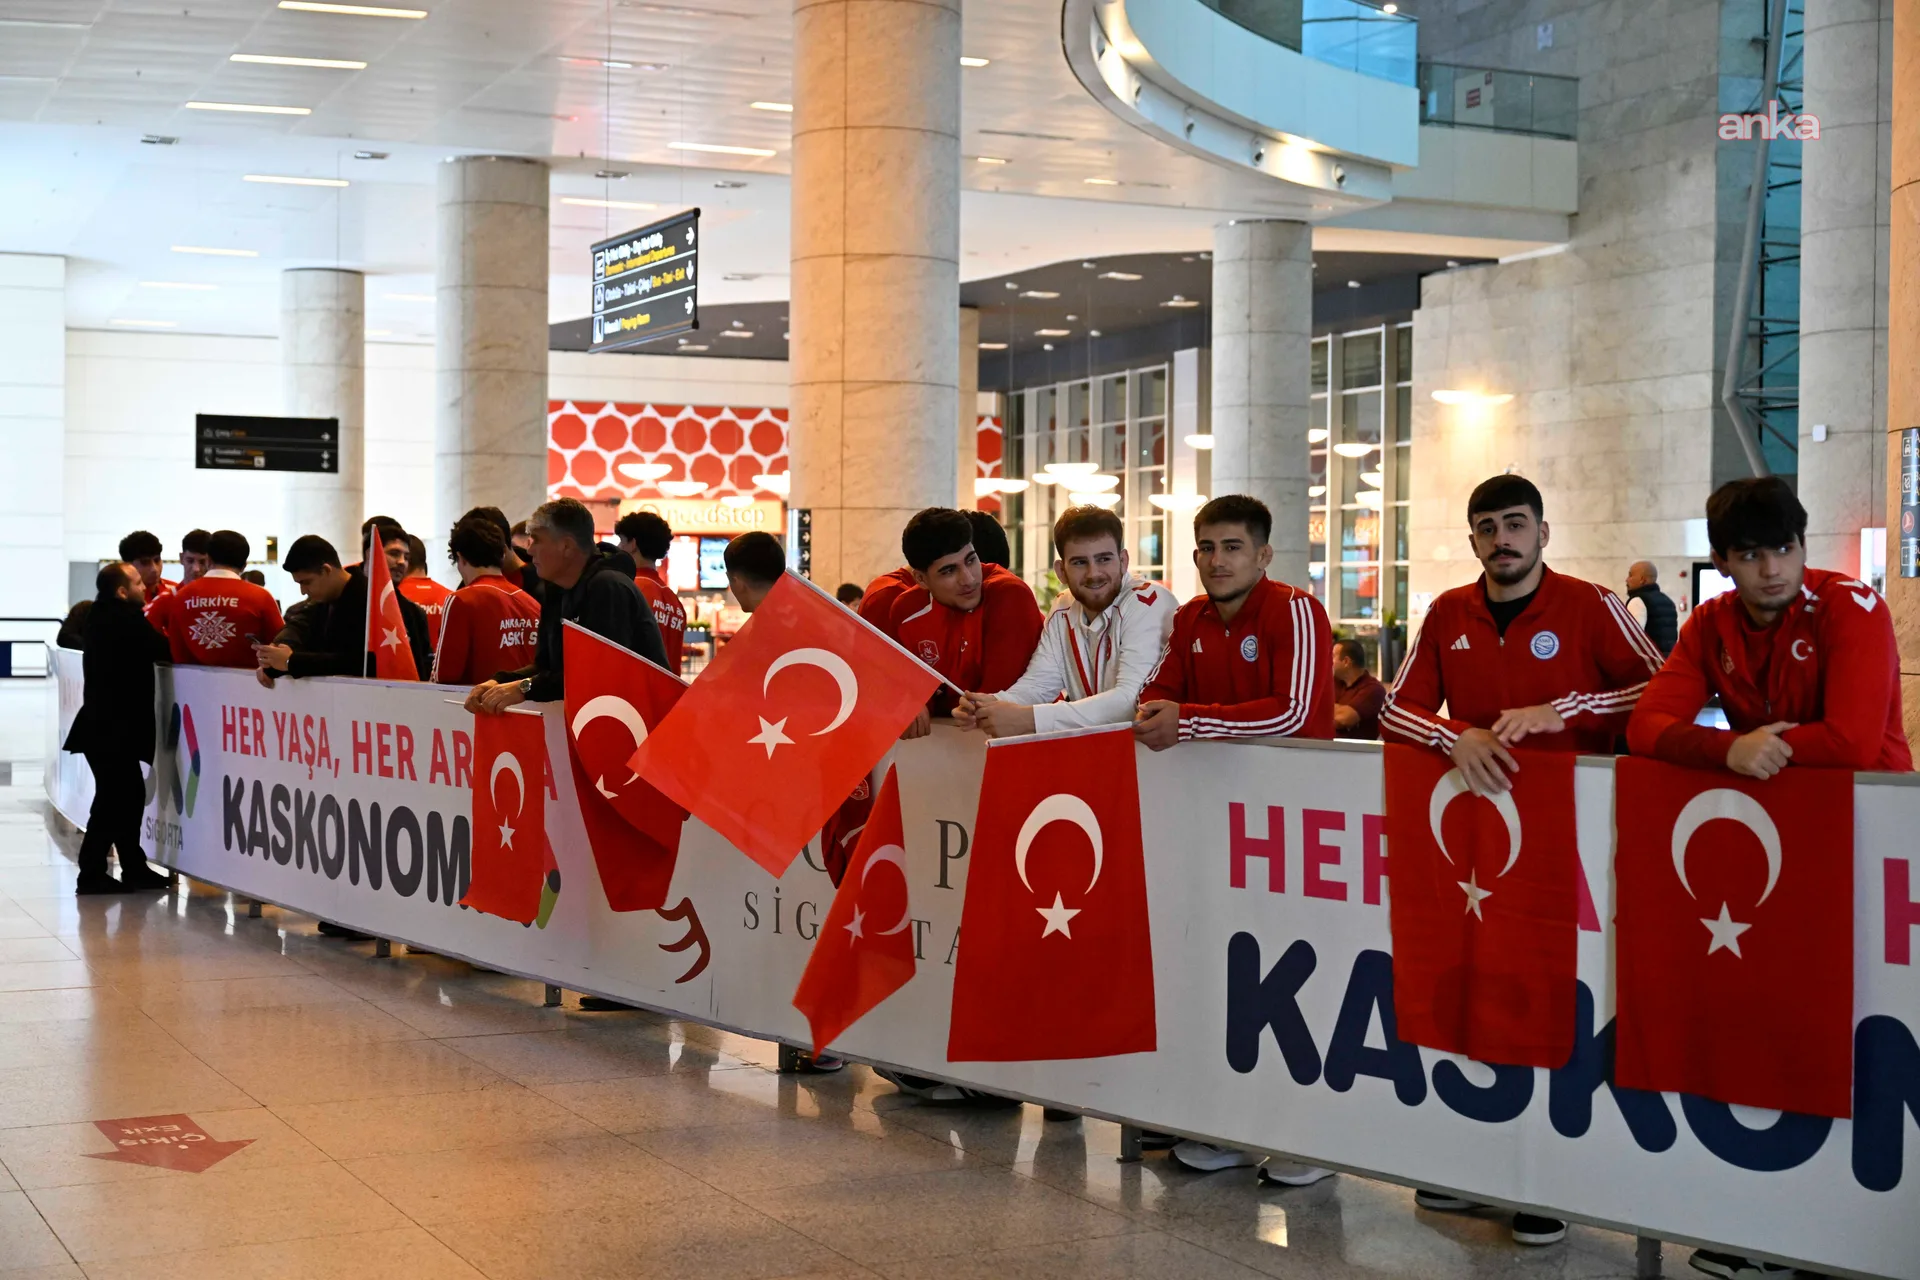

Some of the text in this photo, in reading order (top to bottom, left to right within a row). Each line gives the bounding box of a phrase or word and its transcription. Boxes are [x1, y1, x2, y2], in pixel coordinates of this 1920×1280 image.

[184, 594, 239, 610] TÜRKİYE
[222, 705, 267, 758] HER
[272, 711, 340, 780] YAŞA,
[352, 720, 417, 781] HER
[120, 1124, 182, 1136] Exit
